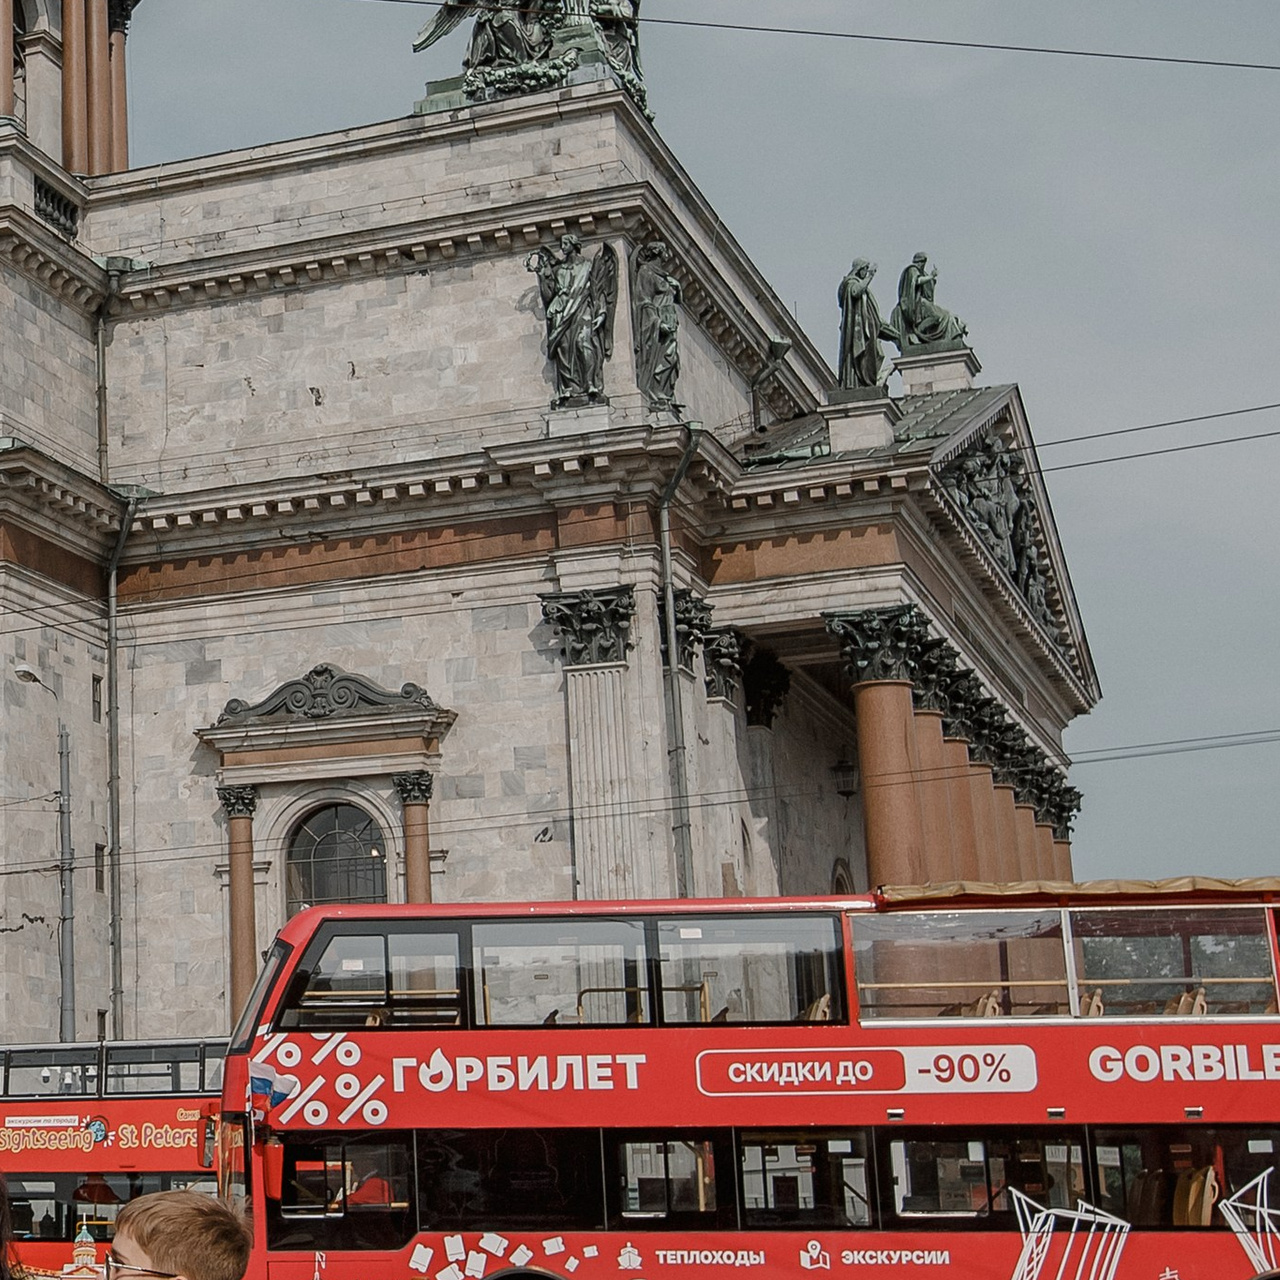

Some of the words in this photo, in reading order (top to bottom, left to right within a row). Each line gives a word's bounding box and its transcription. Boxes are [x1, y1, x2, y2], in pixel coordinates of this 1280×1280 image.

[727, 1061, 830, 1086] СКИДКИ
[836, 1060, 874, 1085] ДО
[917, 1053, 1012, 1083] -90%
[118, 1124, 139, 1148] St
[655, 1250, 765, 1266] ТЕПЛОХОДЫ
[841, 1250, 950, 1265] ЭКСКУРСИИ
